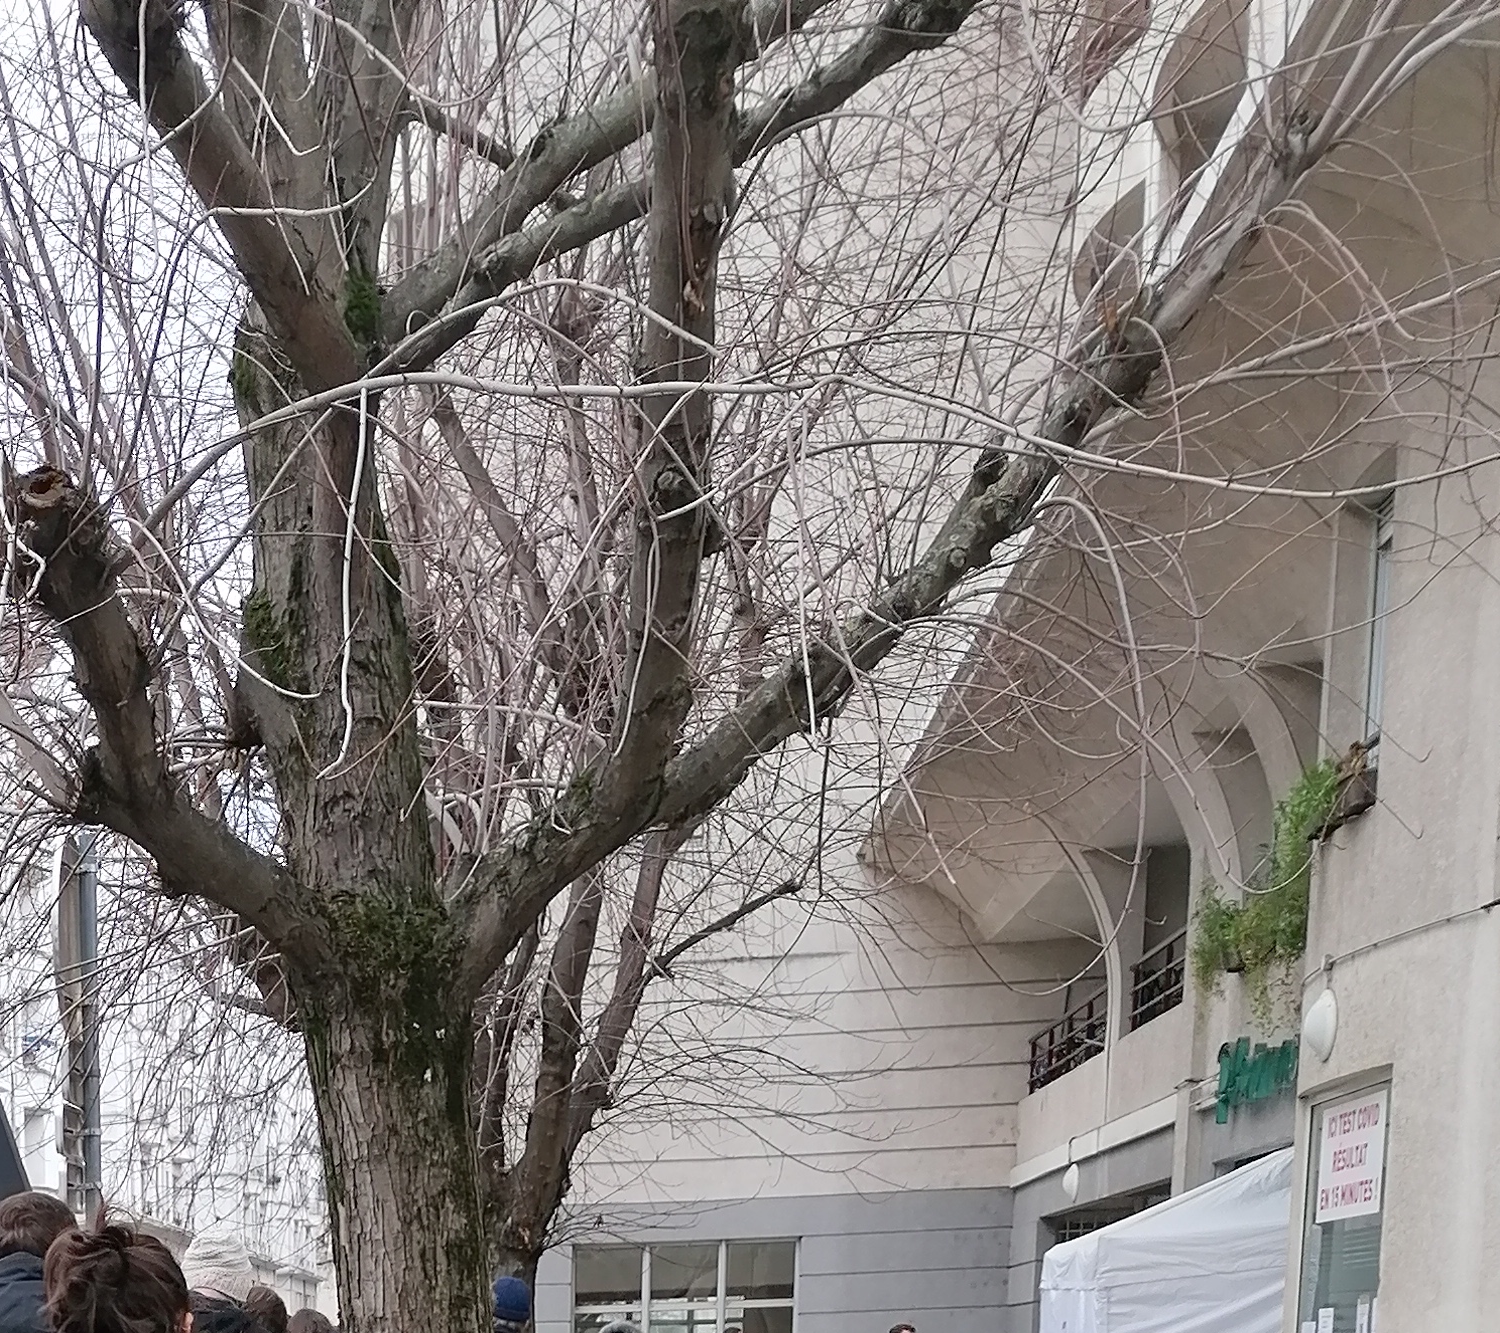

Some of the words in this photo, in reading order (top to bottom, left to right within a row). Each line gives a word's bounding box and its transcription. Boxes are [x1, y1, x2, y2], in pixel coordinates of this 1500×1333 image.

[1327, 1115, 1338, 1138] ICI
[1338, 1109, 1356, 1136] TEST
[1357, 1102, 1380, 1130] COVID
[1331, 1142, 1368, 1173] RÉSULTAT
[1320, 1187, 1330, 1211] EN
[1331, 1185, 1340, 1208] 15
[1340, 1178, 1373, 1206] MINUTES
